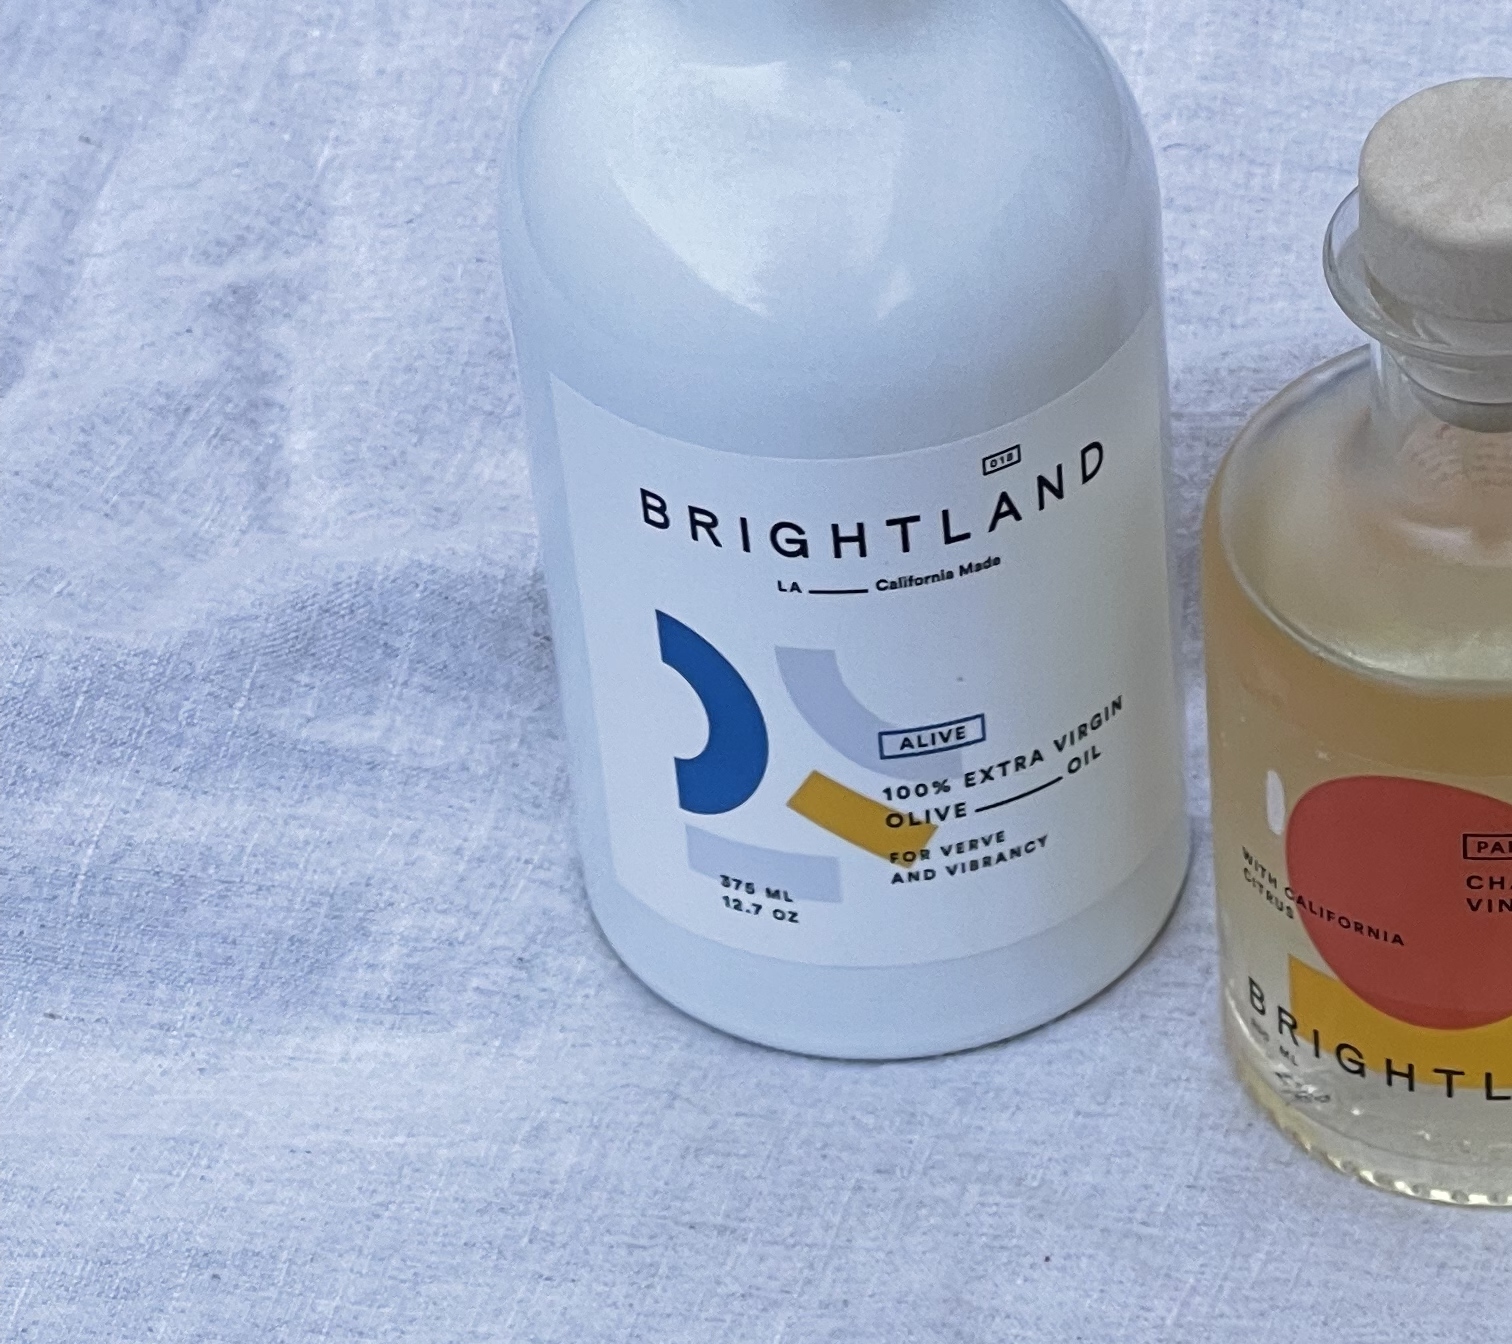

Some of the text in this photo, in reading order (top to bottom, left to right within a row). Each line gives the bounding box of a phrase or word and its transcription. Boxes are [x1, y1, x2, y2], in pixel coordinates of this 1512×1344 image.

[640, 441, 1104, 559] BRIGHTLAND
[777, 555, 1001, 594] LA California Made
[882, 694, 1123, 801] 100% EXTRA VIRGIN
[899, 725, 967, 751] ALIVE
[885, 745, 1102, 829] OLIVE OIL
[889, 830, 1005, 864] FOR VERVE
[891, 834, 1048, 885] AND VIBRANCY
[722, 895, 799, 924] 12.7 OZ
[765, 887, 793, 903] ML
[1284, 886, 1405, 946] CALIFORNIA
